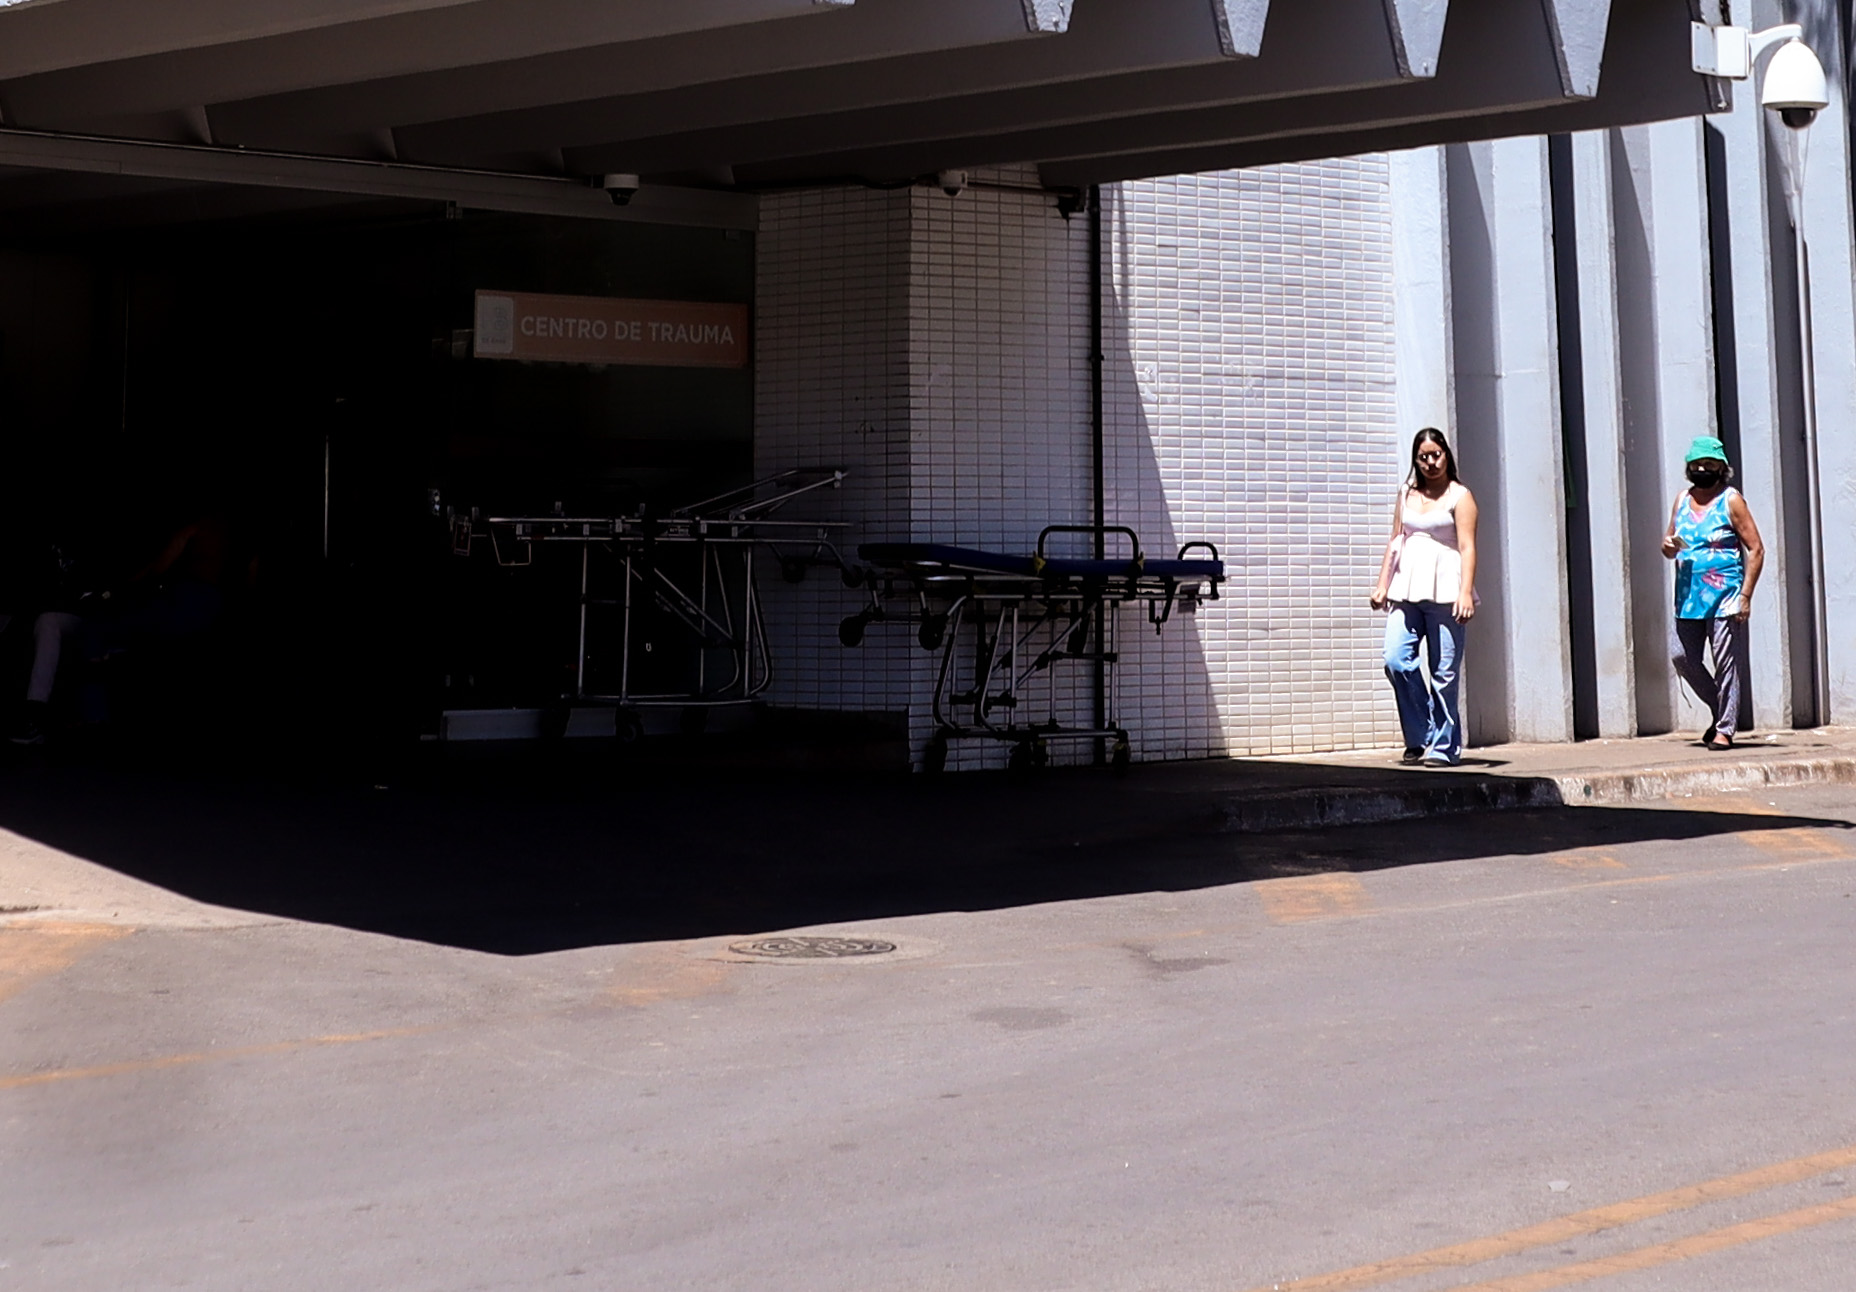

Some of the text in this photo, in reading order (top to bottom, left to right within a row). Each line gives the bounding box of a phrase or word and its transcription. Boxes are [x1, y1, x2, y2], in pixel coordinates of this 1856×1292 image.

[520, 316, 735, 345] CENTRO DE TRAUMA
